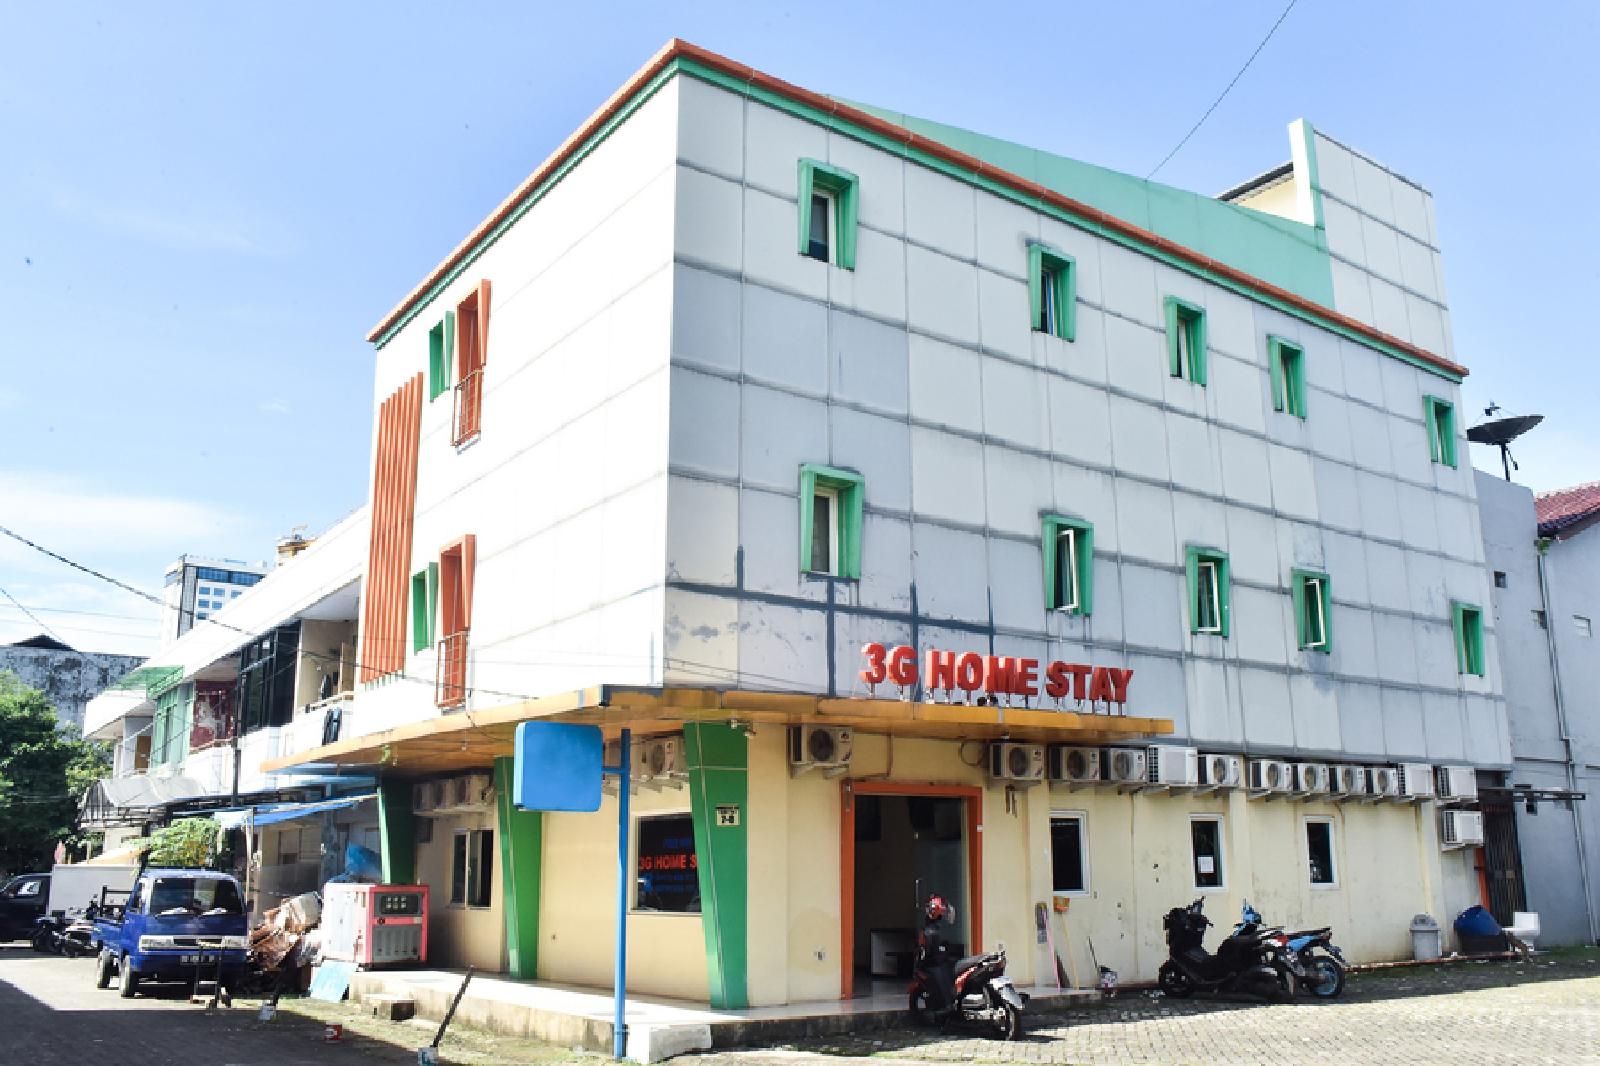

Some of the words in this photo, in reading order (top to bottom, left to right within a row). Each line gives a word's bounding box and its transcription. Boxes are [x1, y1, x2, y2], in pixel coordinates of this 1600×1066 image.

[860, 642, 919, 686] 3G
[925, 649, 1039, 696] HOME
[1045, 660, 1134, 703] STAY
[656, 854, 687, 870] HOME
